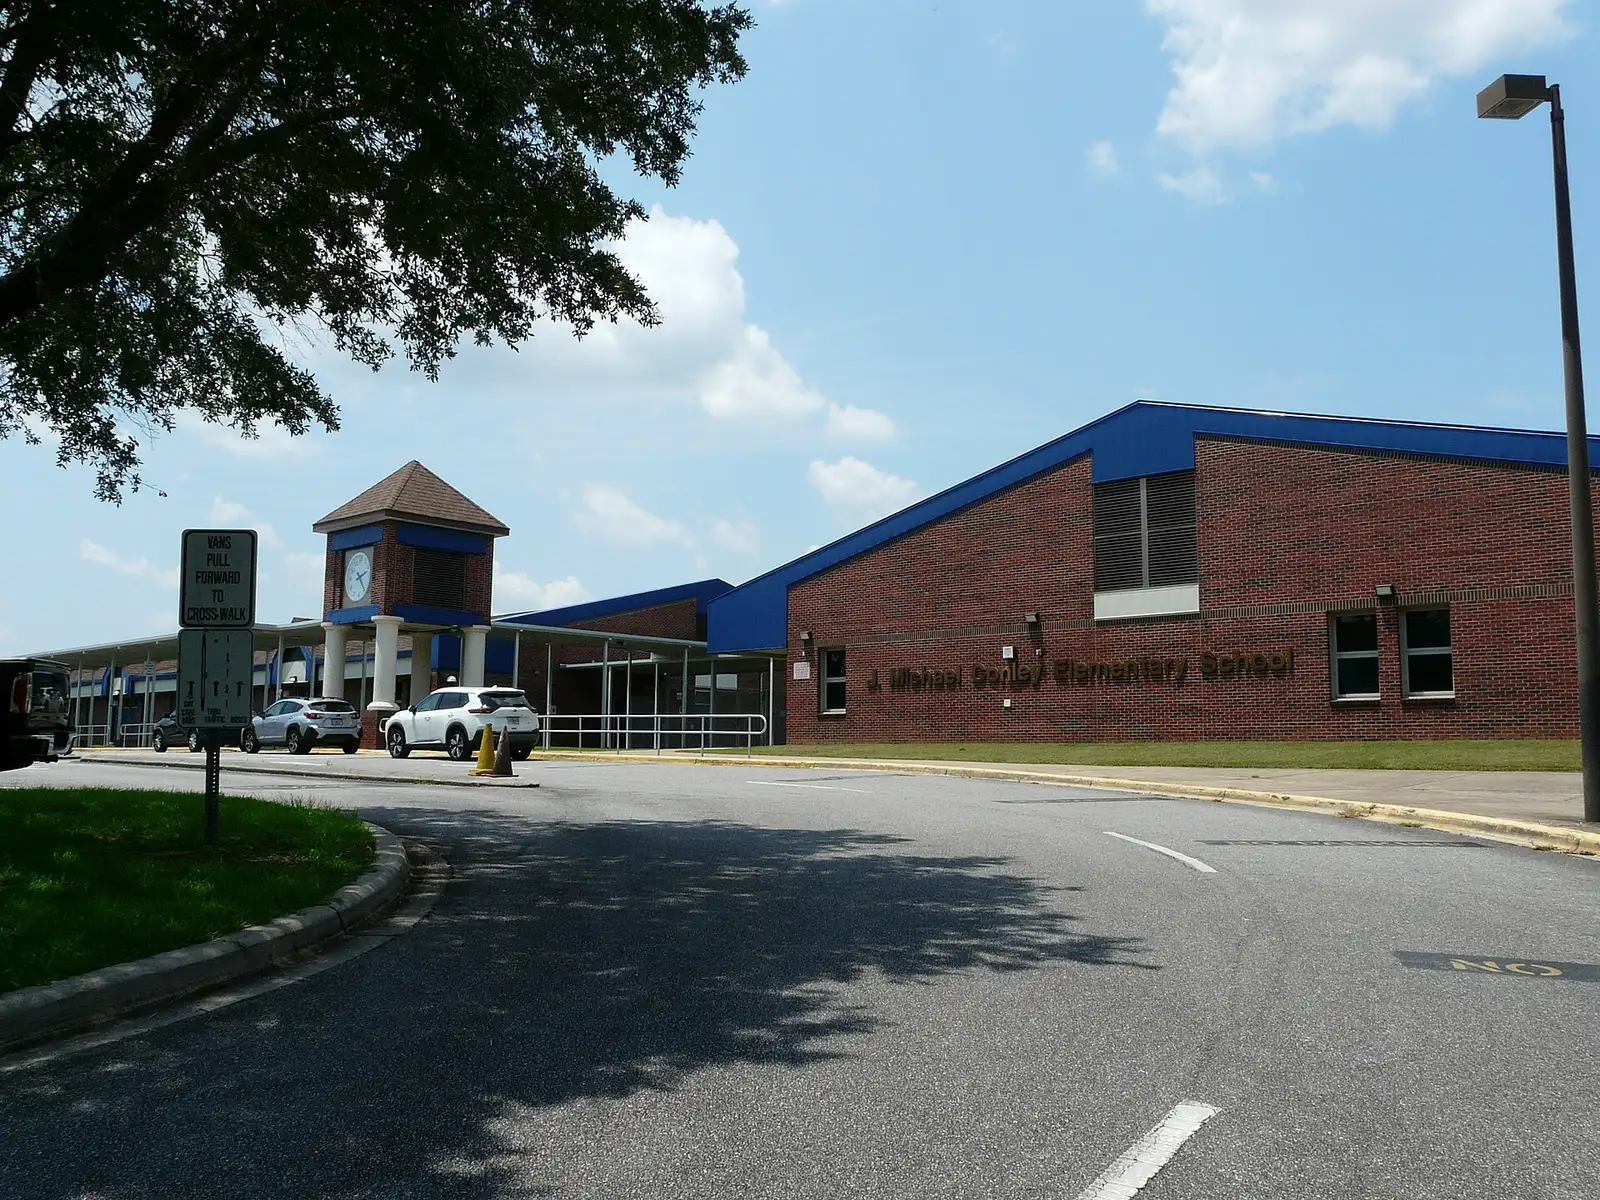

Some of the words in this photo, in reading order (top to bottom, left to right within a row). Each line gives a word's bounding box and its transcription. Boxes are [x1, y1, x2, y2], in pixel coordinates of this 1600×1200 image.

[208, 536, 231, 549] VANS
[207, 553, 230, 567] PULL
[195, 571, 240, 584] FORWARD
[212, 589, 224, 603] TO
[187, 607, 246, 620] CROSS-WALK
[889, 665, 962, 690] Michael
[971, 661, 1041, 686] Conley
[1053, 656, 1188, 680] Elementary
[1200, 649, 1294, 675] School
[1450, 958, 1563, 976] NO
